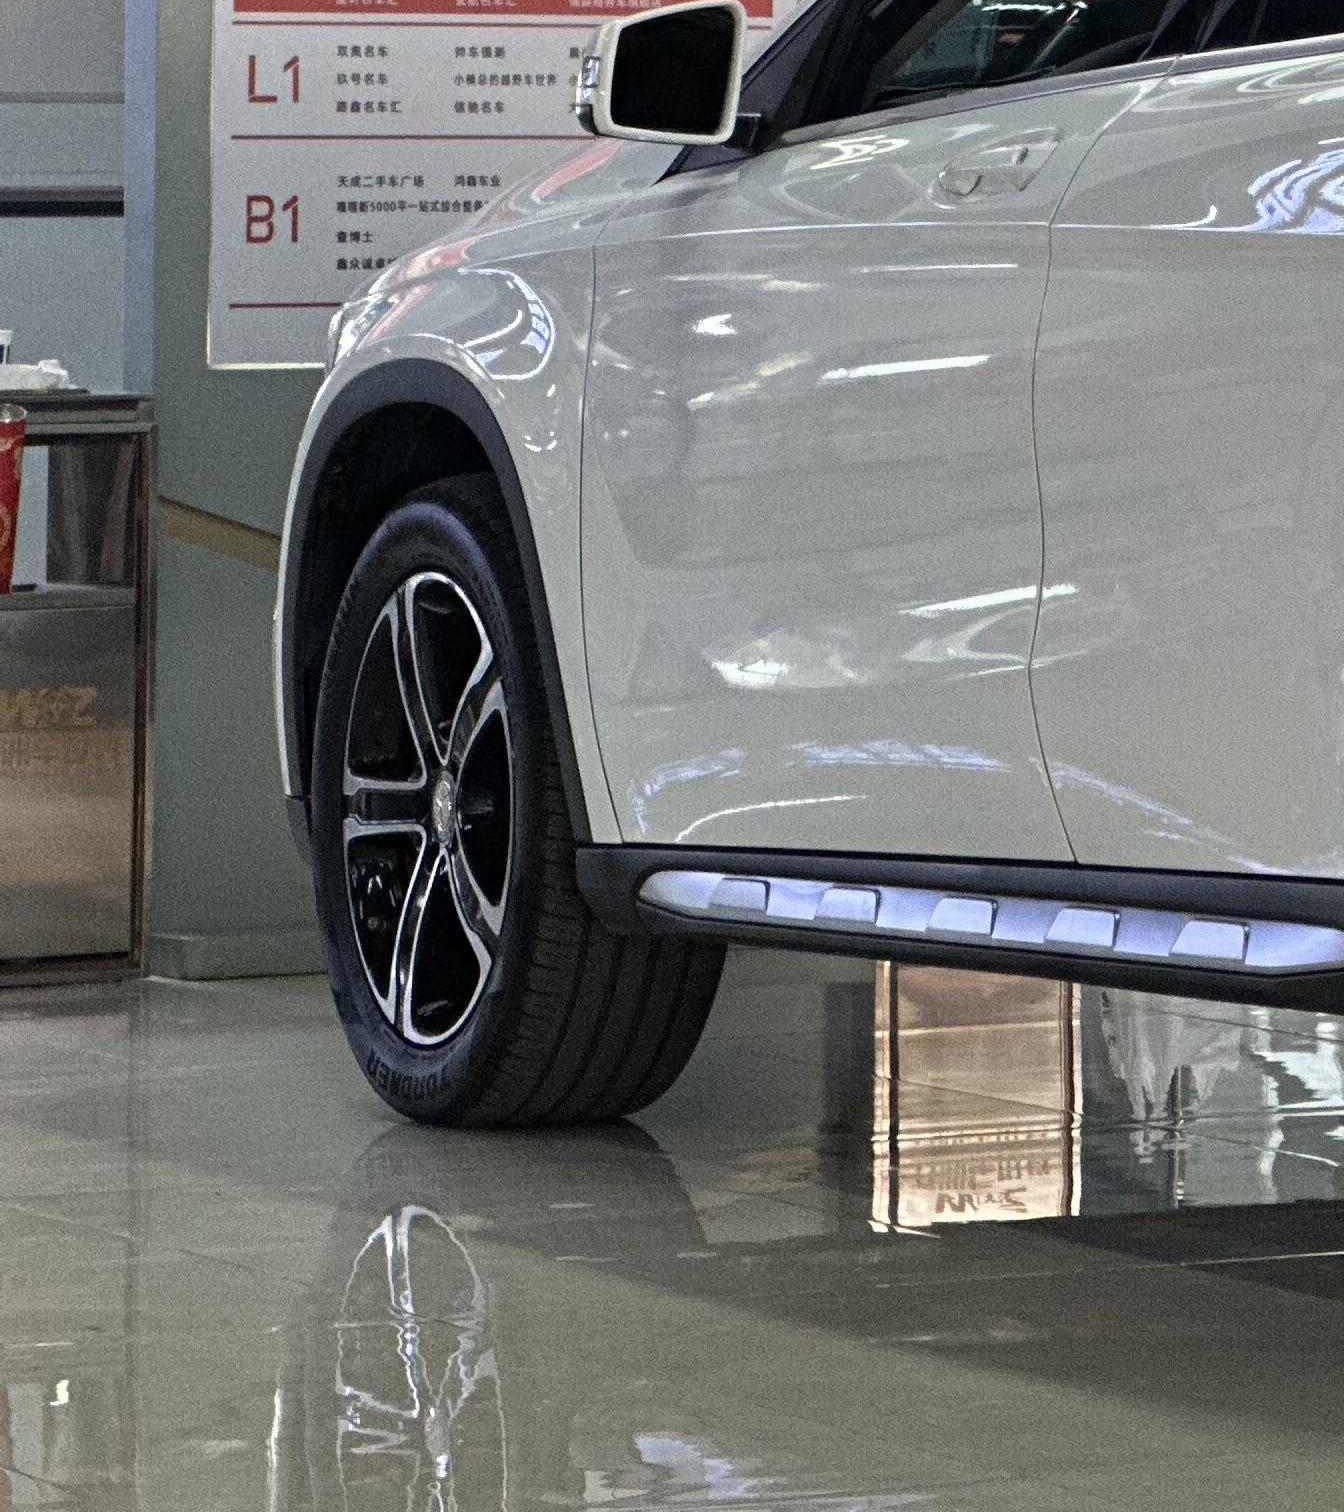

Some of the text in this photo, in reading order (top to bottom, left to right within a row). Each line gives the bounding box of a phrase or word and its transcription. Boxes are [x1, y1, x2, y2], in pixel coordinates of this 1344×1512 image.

[247, 56, 300, 104] L1
[337, 174, 425, 189] 天成二手车广场
[245, 193, 300, 245] B1
